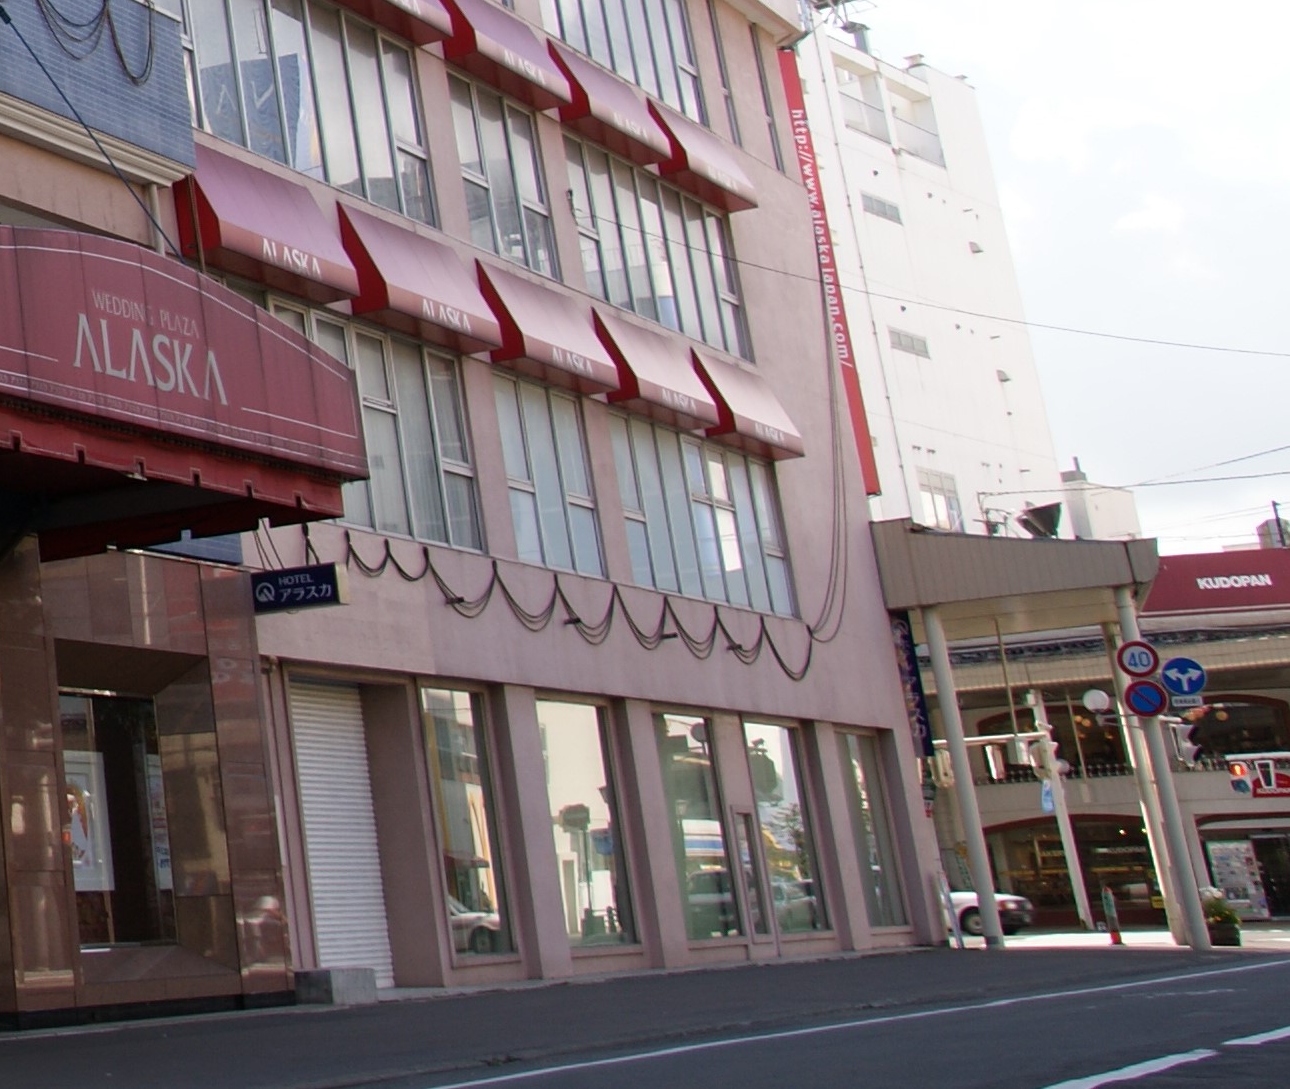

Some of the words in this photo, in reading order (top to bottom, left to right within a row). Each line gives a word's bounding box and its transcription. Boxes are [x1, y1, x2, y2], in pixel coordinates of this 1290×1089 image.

[159, 309, 199, 339] PLAZA
[73, 313, 229, 406] ALASKA
[279, 573, 314, 586] HOTEL
[1196, 574, 1272, 590] KUDOPAN
[279, 583, 332, 603] アラスカ
[1127, 651, 1150, 668] 40
